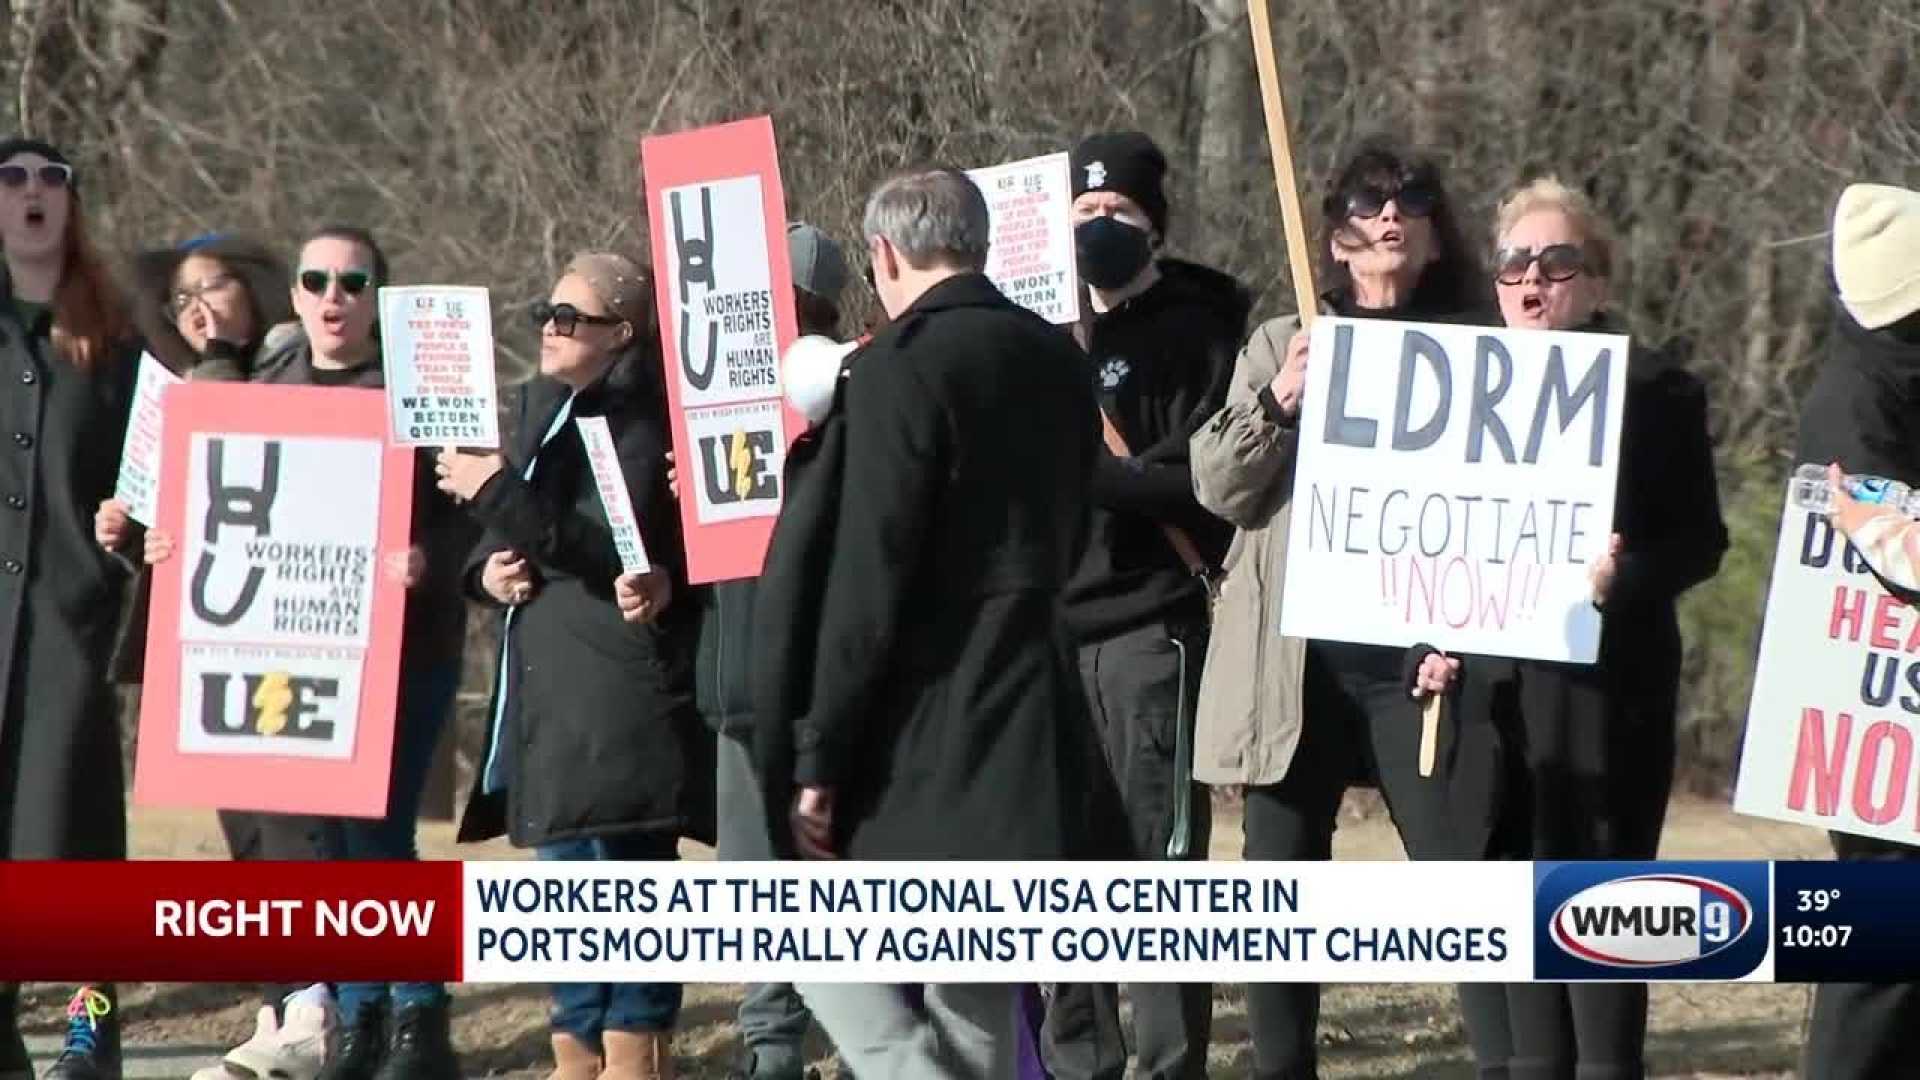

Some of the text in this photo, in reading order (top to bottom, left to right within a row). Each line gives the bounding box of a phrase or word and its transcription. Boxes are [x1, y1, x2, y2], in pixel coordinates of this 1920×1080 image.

[723, 312, 771, 334] RIGHTS
[753, 331, 772, 346] ARE
[726, 348, 774, 369] HUMAN
[728, 368, 776, 388] RIGHTS
[402, 397, 430, 409] WE
[1323, 324, 1612, 467] LDRM
[413, 411, 480, 424] RETURN
[1308, 482, 1594, 565] NEGOTIATE
[277, 564, 366, 584] RIGHTS
[329, 587, 362, 598] ARE
[273, 597, 361, 616] HUMAN
[273, 616, 359, 635] RIGHTS
[1861, 652, 1920, 714] US
[1787, 707, 1920, 832] NO
